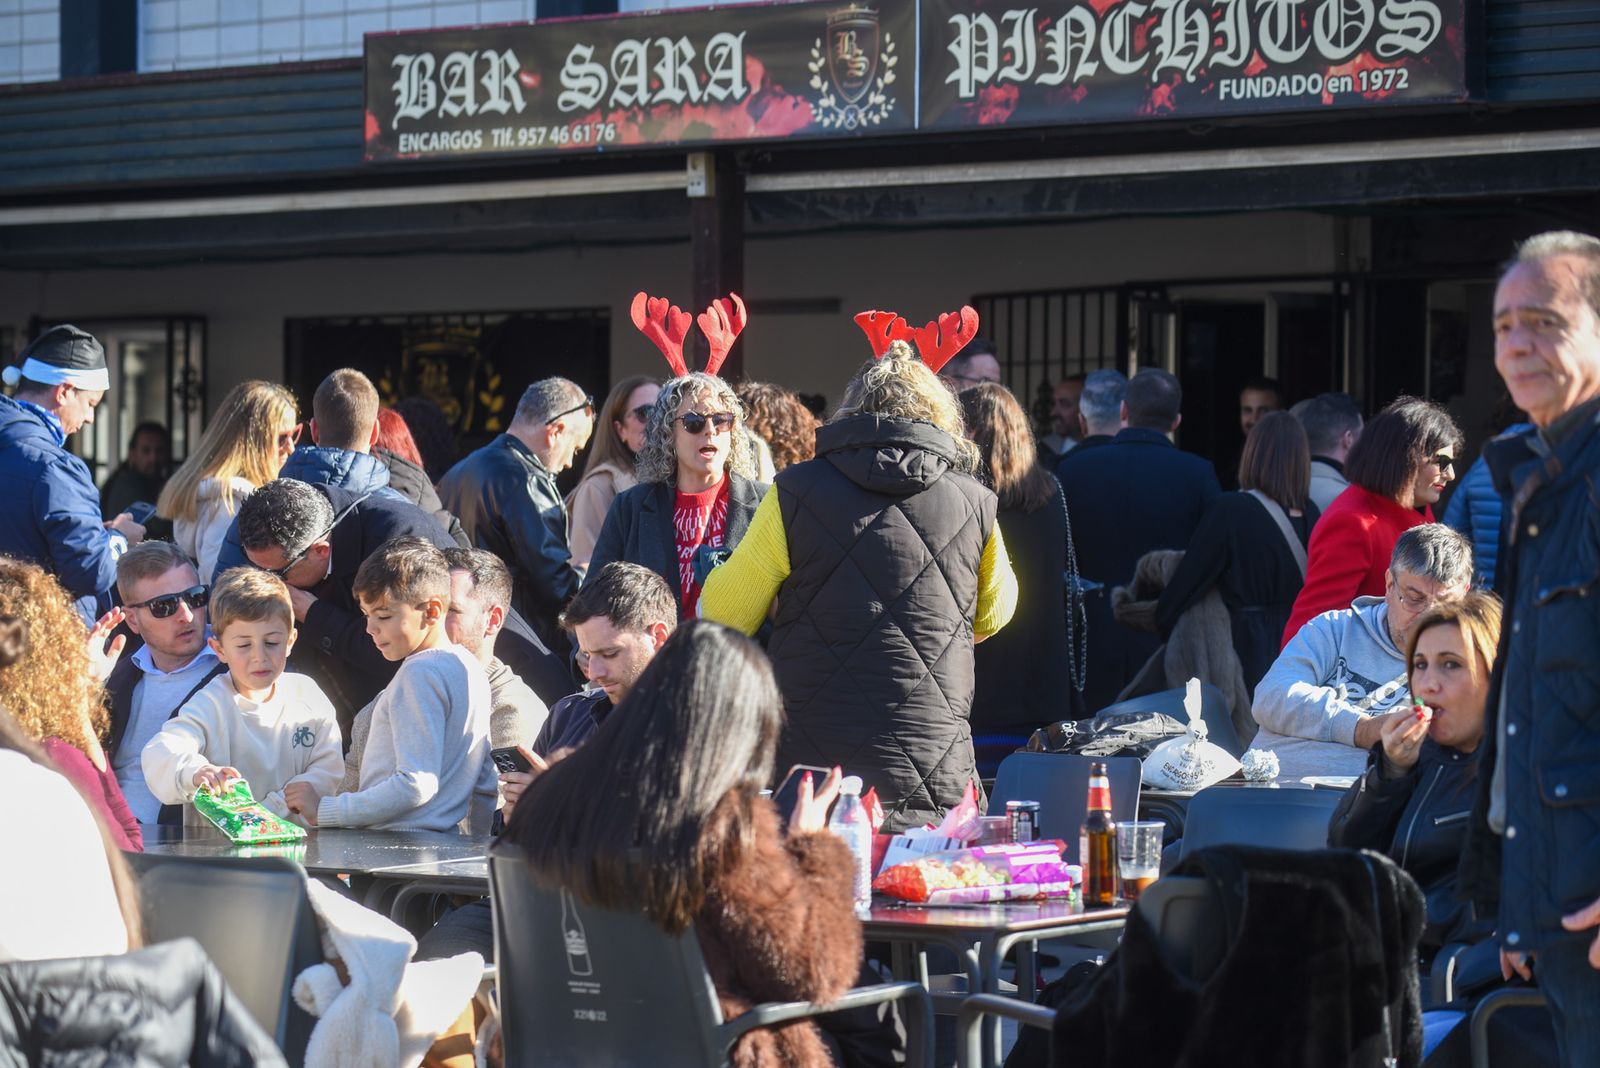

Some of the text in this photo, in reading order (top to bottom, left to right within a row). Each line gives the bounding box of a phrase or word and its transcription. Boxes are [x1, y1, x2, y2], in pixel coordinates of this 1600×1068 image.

[391, 30, 748, 131] BAR SARA
[945, 0, 1443, 98] PINCHITOS
[1219, 68, 1409, 100] FUNDADO en 1972
[399, 129, 483, 152] ENCARGOS
[518, 126, 547, 147] 957
[549, 124, 569, 144] 46
[572, 124, 590, 142] 61
[595, 123, 616, 141] 76
